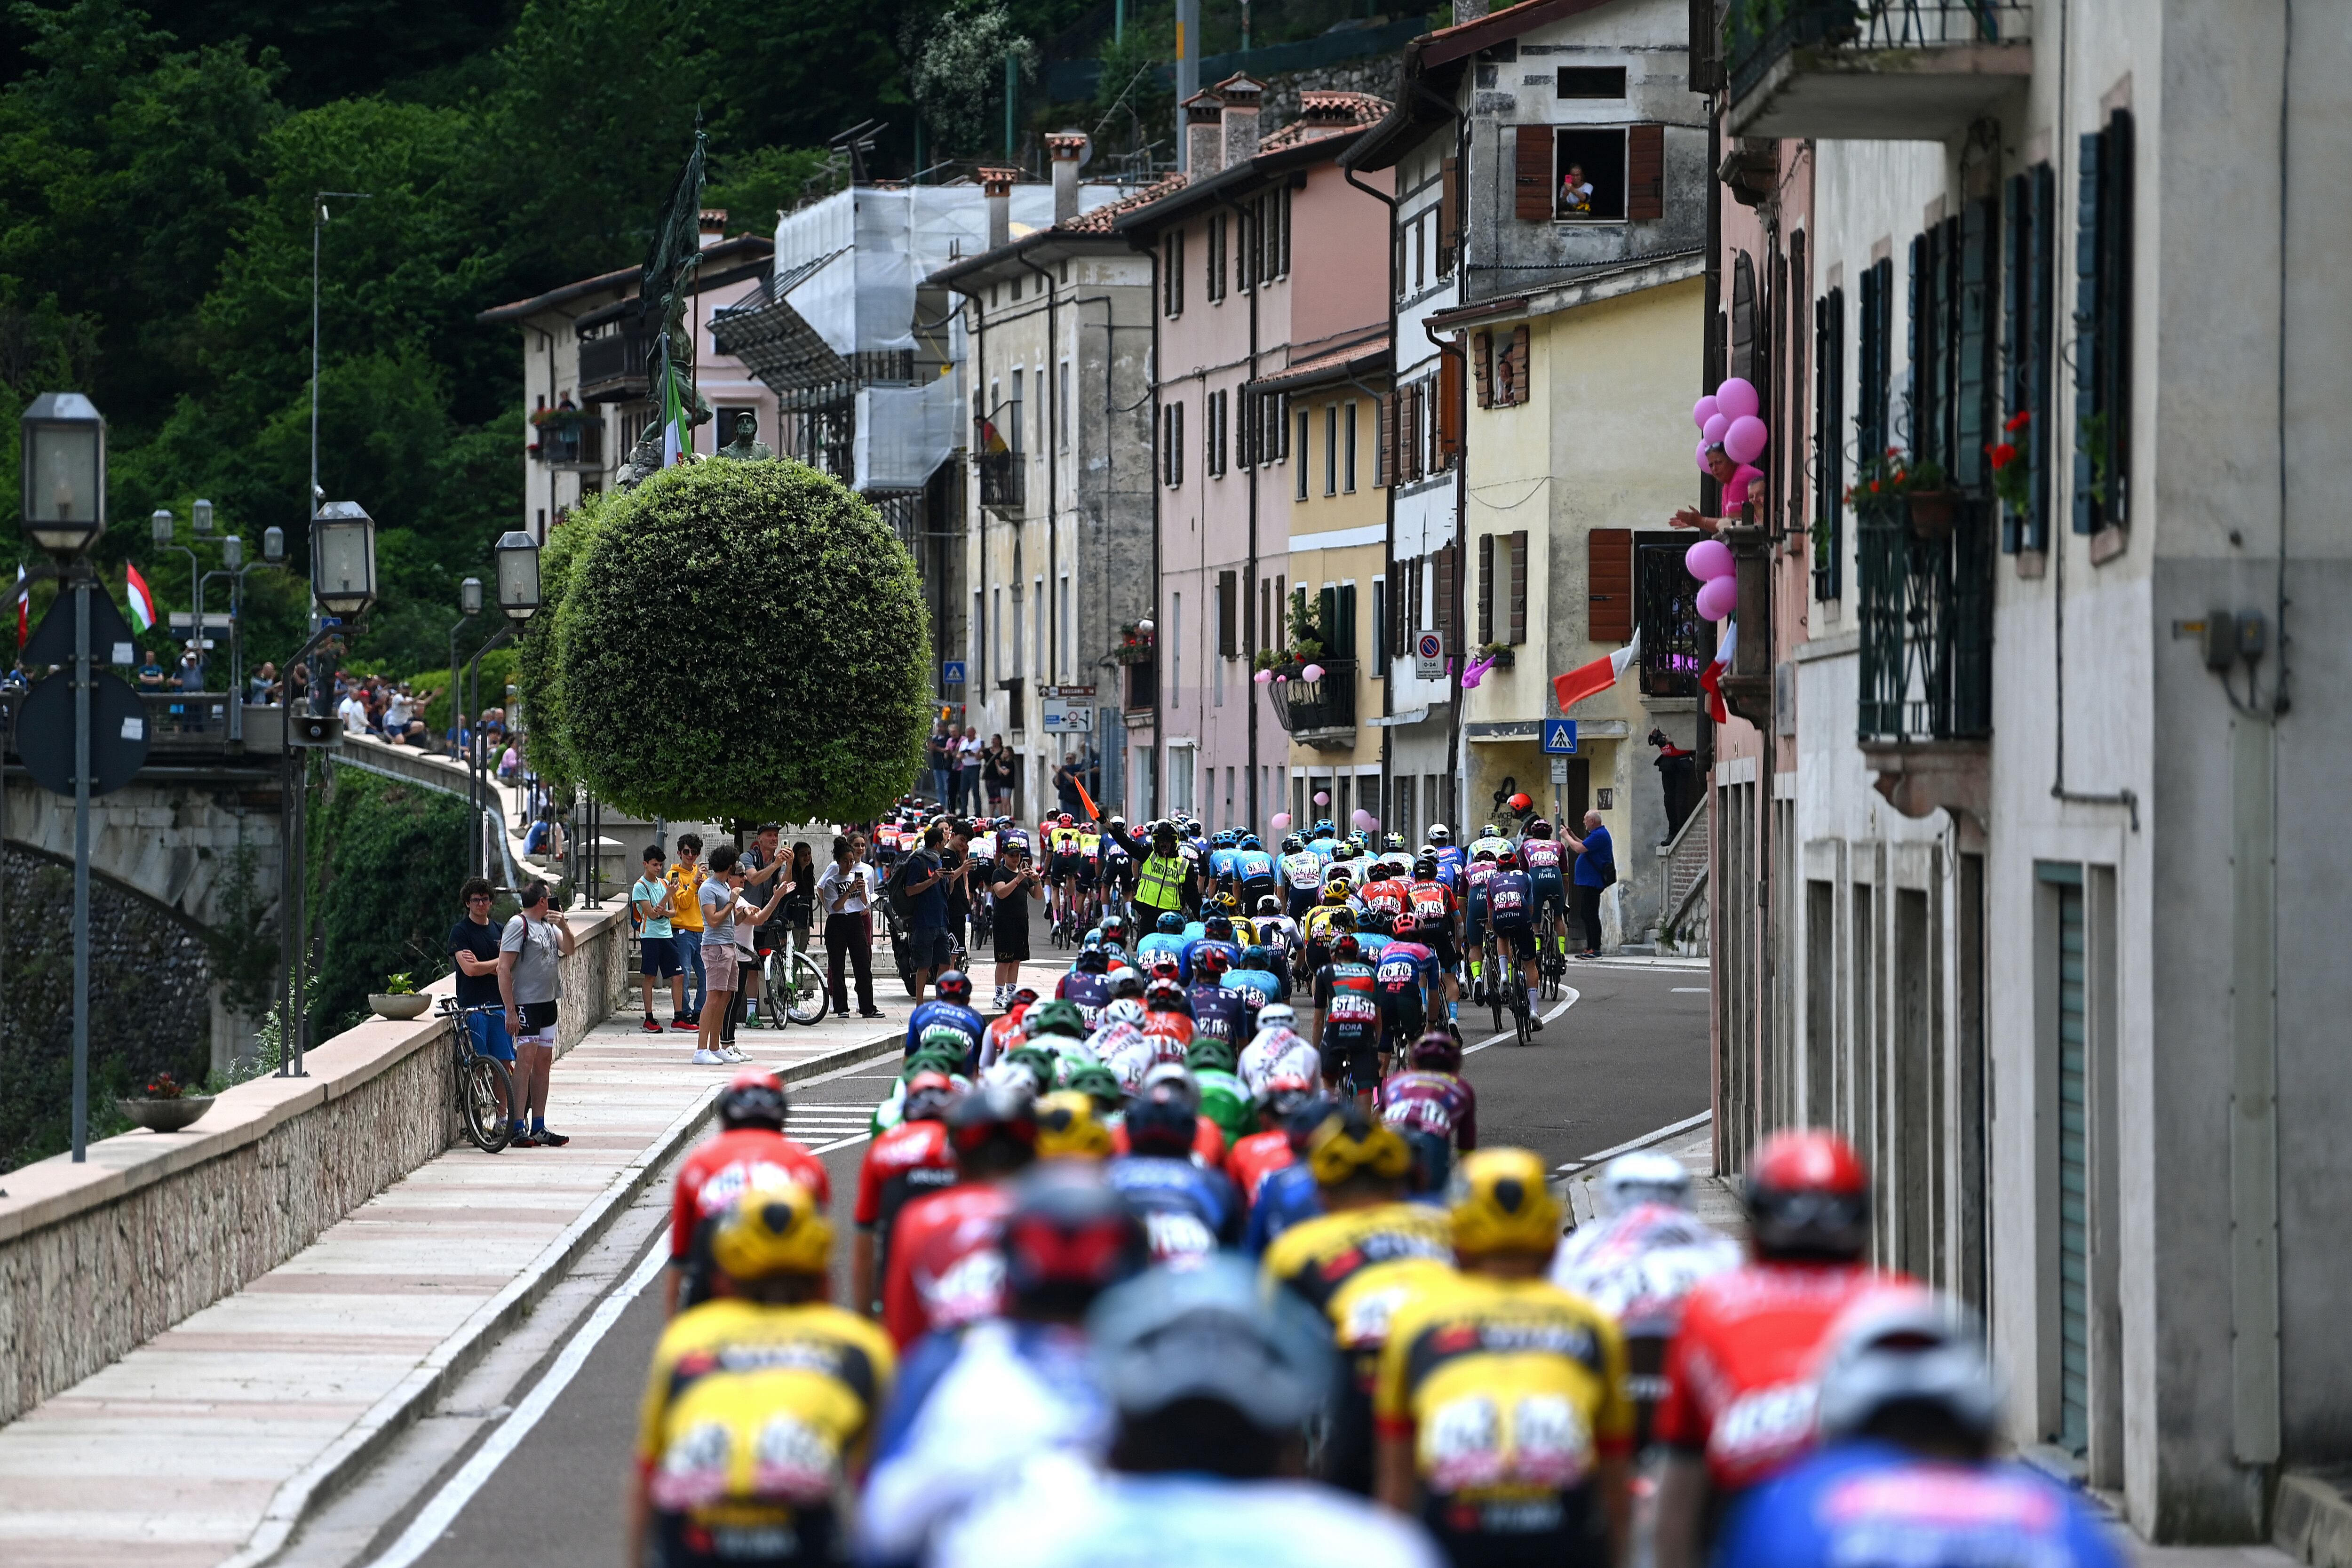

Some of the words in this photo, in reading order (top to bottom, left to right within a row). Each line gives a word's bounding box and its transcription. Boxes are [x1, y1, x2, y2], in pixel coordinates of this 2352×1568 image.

[1248, 862, 1255, 871] 81
[1391, 898, 1399, 909] 68
[1431, 902, 1442, 913] 48
[1496, 912, 1520, 920] FANTINI
[1196, 939, 1236, 949] Groupama
[1381, 965, 1392, 977] 76
[1397, 962, 1409, 976] 76
[1251, 990, 1263, 1003] 38
[1337, 996, 1349, 1011] 57
[1359, 998, 1372, 1011] 57
[1339, 1022, 1362, 1032] BORA
